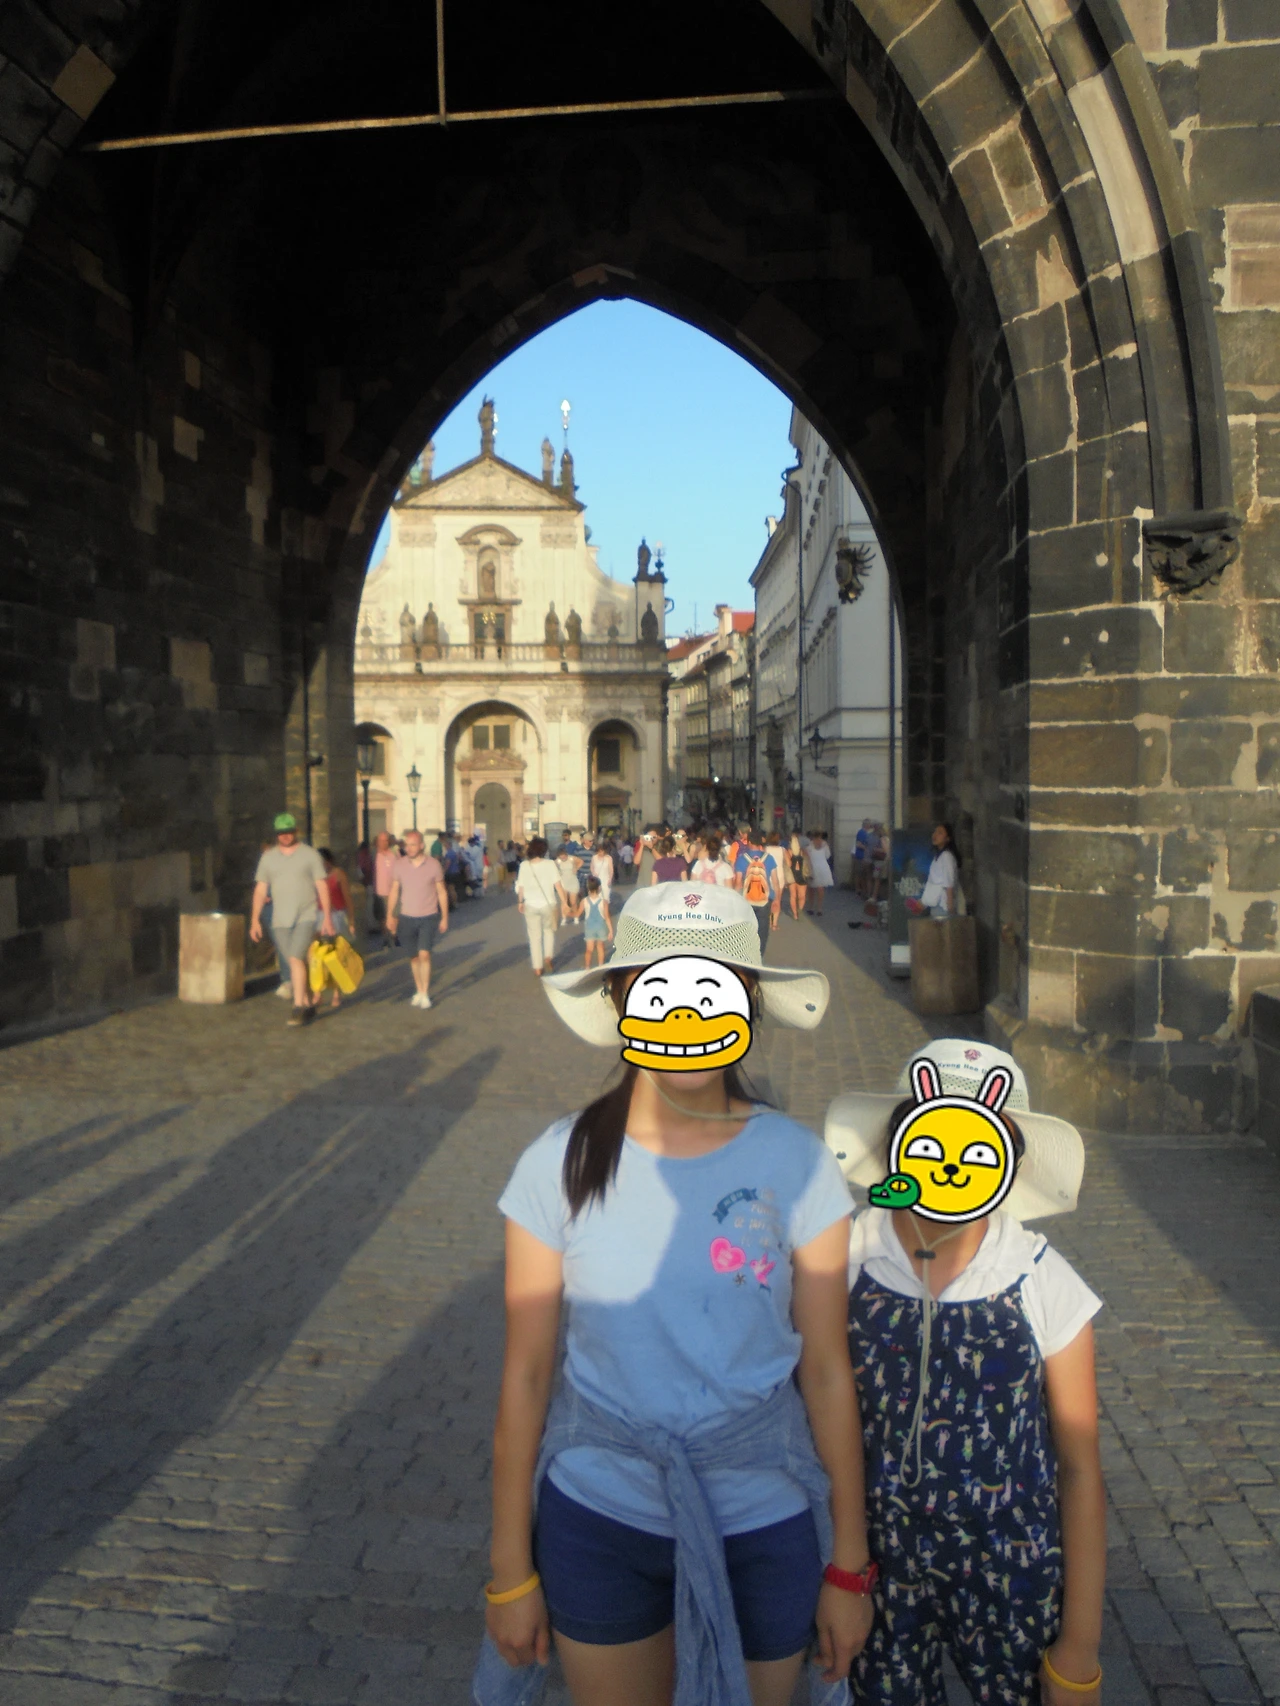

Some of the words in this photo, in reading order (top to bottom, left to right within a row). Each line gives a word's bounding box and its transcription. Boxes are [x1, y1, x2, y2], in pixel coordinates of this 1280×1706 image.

[658, 913, 683, 922] Kyung
[686, 911, 702, 920] Hee
[704, 913, 724, 925] Univ.
